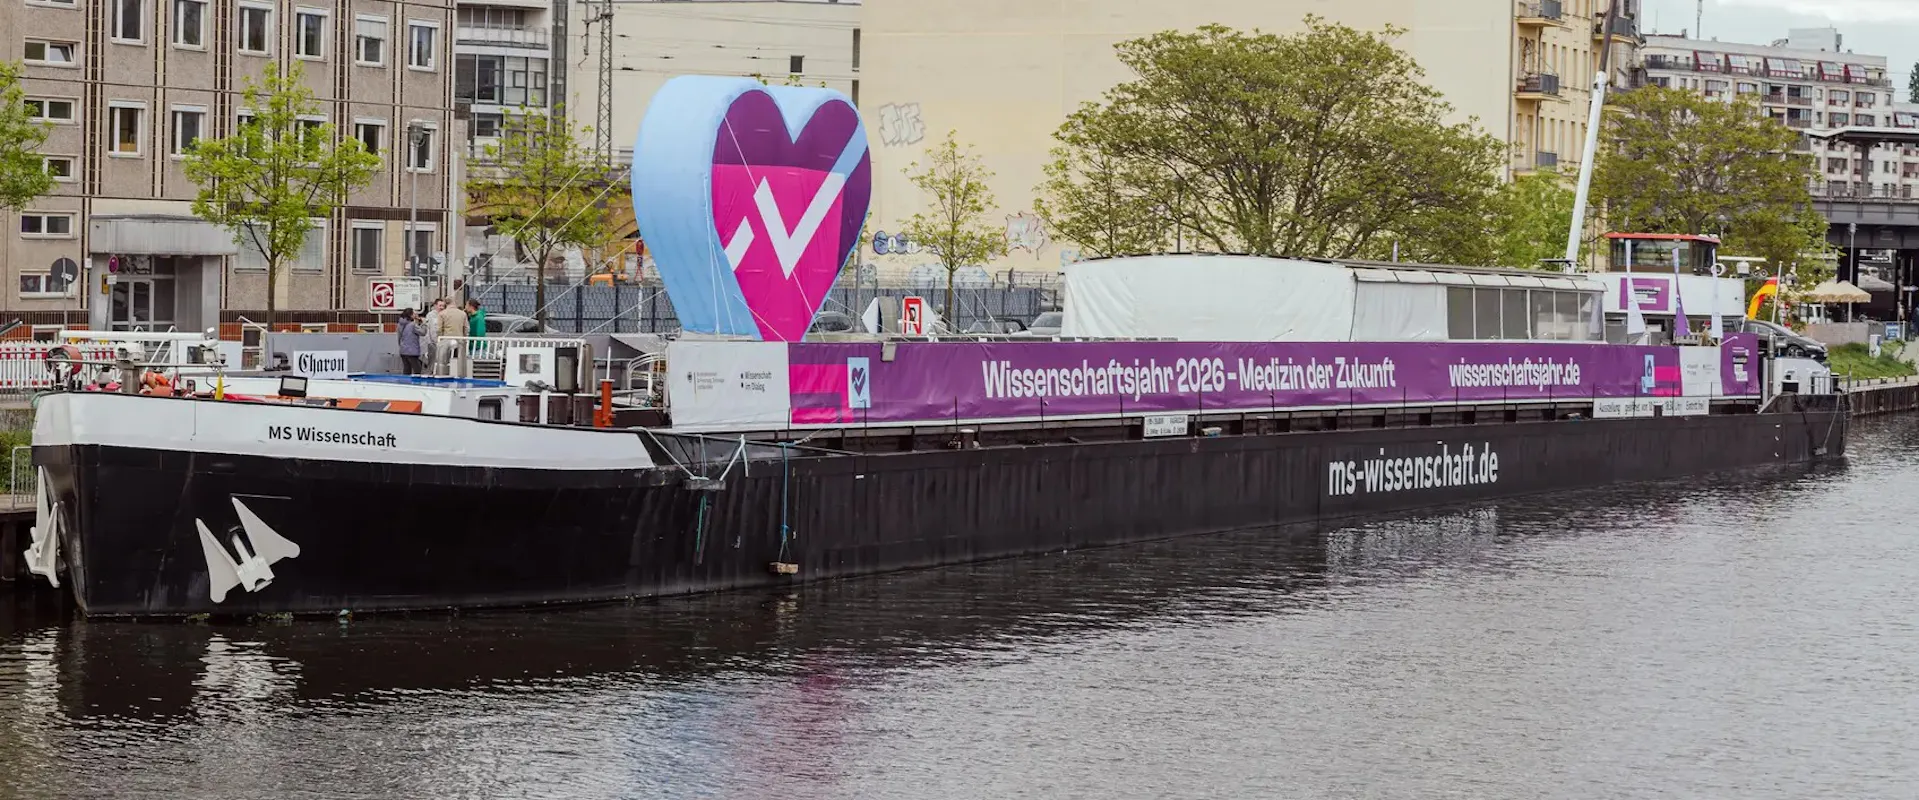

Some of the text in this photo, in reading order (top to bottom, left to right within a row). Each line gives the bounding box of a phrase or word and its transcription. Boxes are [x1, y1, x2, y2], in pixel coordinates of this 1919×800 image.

[298, 352, 345, 378] Charon
[982, 358, 1174, 402] Wissenschaftsjahr
[1176, 357, 1225, 393] 2026
[1238, 357, 1306, 391] Medizin
[1306, 357, 1334, 390] der
[1334, 356, 1397, 389] Zukunft
[1449, 357, 1581, 392] wissenschaftsjahr.de
[268, 425, 397, 448] MS Wissenschaft
[1328, 442, 1499, 495] ms-wissenschaft.de
